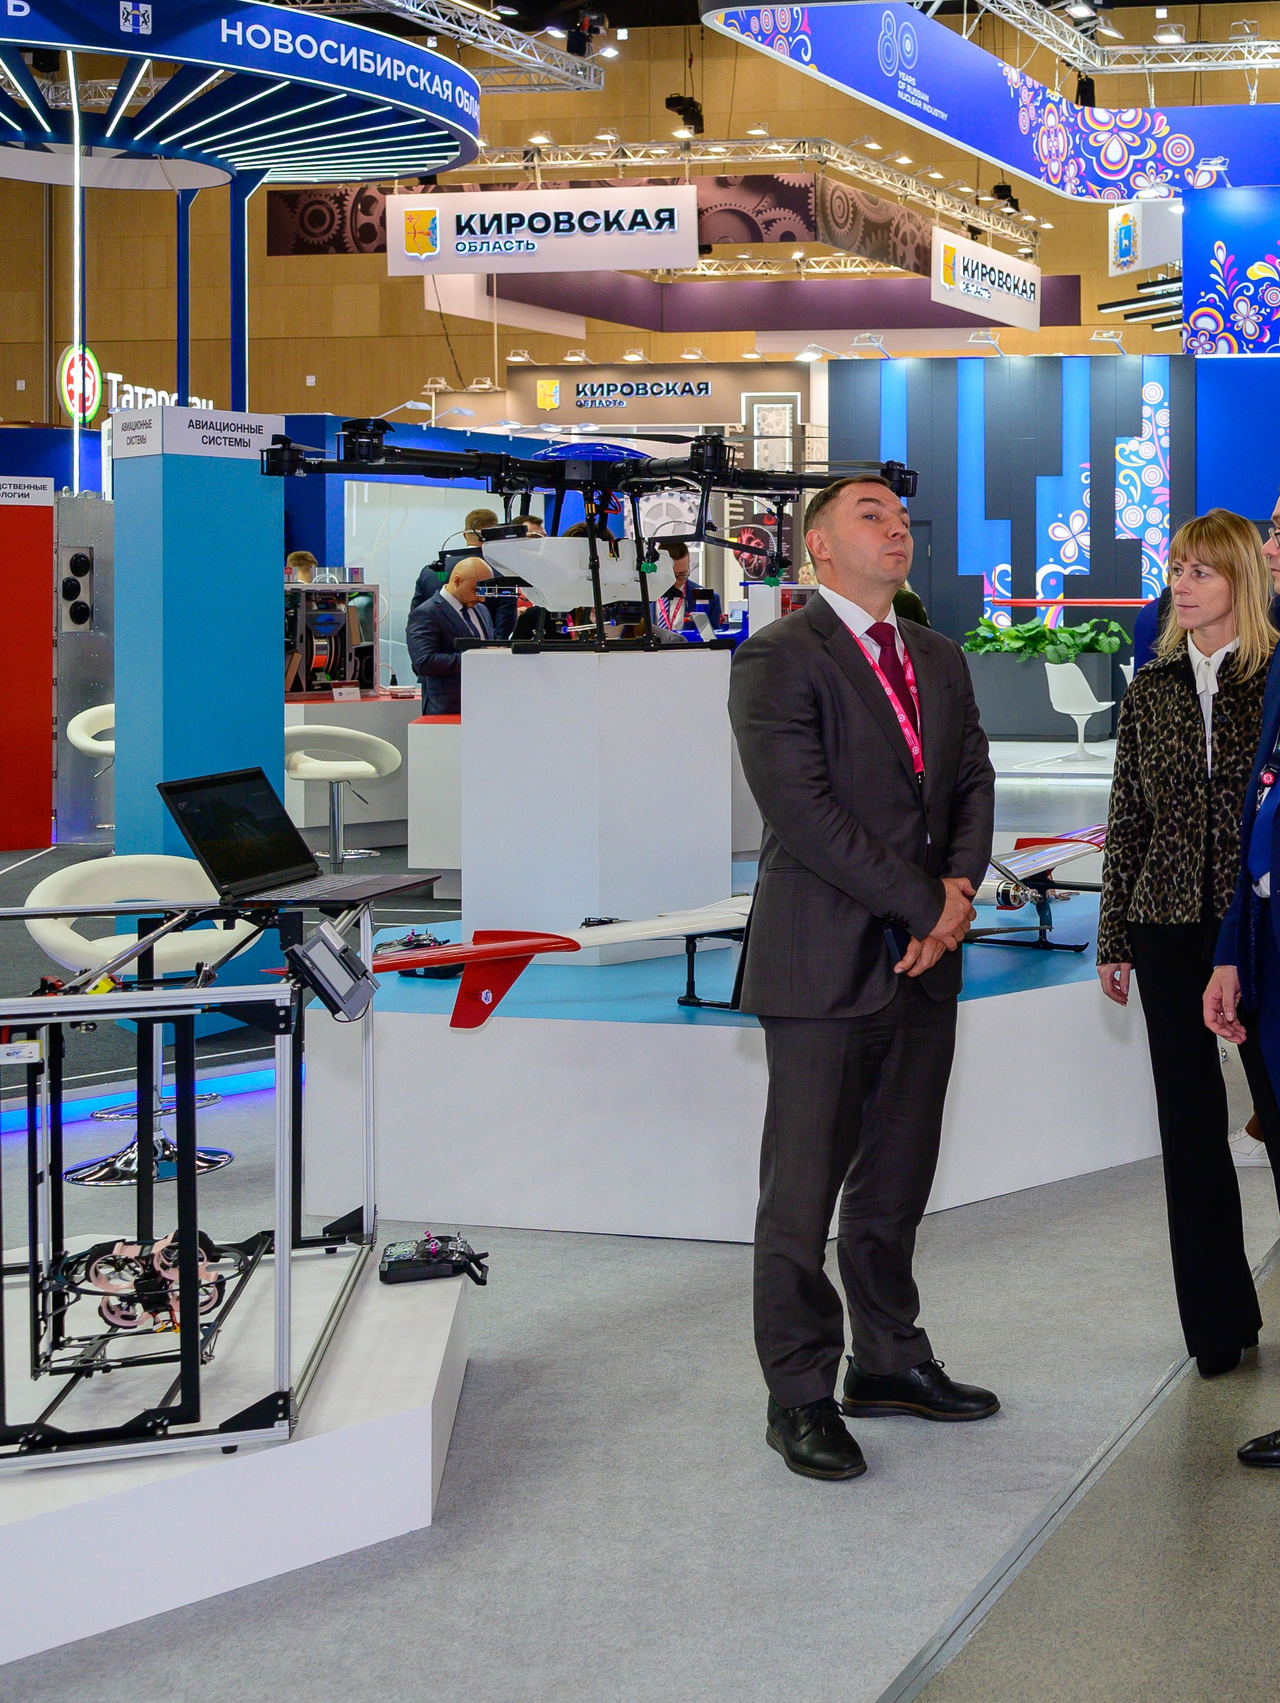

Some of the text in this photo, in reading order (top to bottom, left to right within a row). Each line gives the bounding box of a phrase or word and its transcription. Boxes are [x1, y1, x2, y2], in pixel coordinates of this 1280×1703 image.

[220, 18, 453, 103] НОВОСИБИРСКАЯ
[898, 70, 916, 86] YEARS
[897, 80, 930, 103] OF RUSSIAN
[897, 90, 948, 121] NUCLEAR INDUSTRY
[455, 208, 677, 237] КИРОВСКАЯ
[455, 239, 537, 253] ОБЛАСТЬ
[961, 256, 1036, 302] КИРОВСКАЯ
[576, 381, 712, 397] КИРОВСКАЯ
[576, 400, 627, 408] ОБЛАСТЬ
[121, 419, 153, 432] АВИАЦИОННЫЕ
[187, 419, 264, 435] АВИАЦИОННЫЕ
[126, 434, 147, 446] СИСТЕМЫ
[201, 435, 251, 448] СИСТЕМЫ
[0, 483, 48, 491] СТВЕННЫЕ
[0, 491, 30, 499] ЛОГИИ
